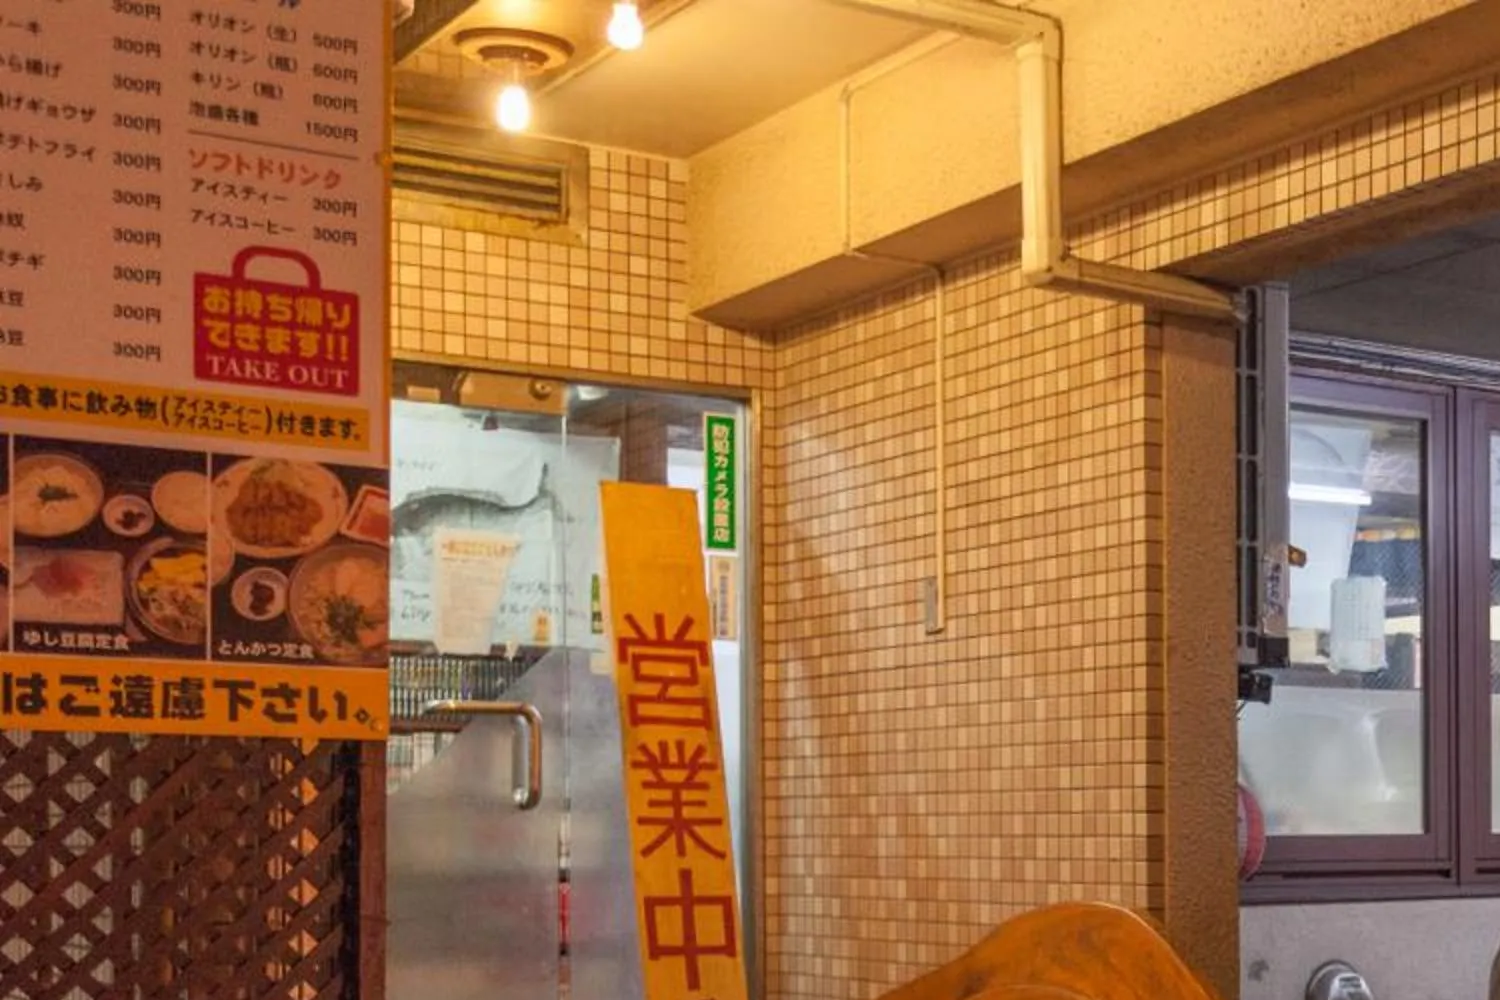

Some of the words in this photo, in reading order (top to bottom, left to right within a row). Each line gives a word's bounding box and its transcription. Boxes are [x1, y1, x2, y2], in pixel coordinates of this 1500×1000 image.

[0, 16, 41, 35] ーキ
[0, 132, 96, 162] テトフライ
[0, 172, 43, 192] しみ
[189, 149, 342, 190] ソフトドリンク
[191, 177, 288, 204] アイスティー
[191, 209, 296, 235] アイスコーヒー
[202, 286, 350, 330] お持ち帰り
[206, 354, 281, 381] TAKE
[288, 364, 348, 388] OUT
[218, 640, 315, 660] とんかつ定食
